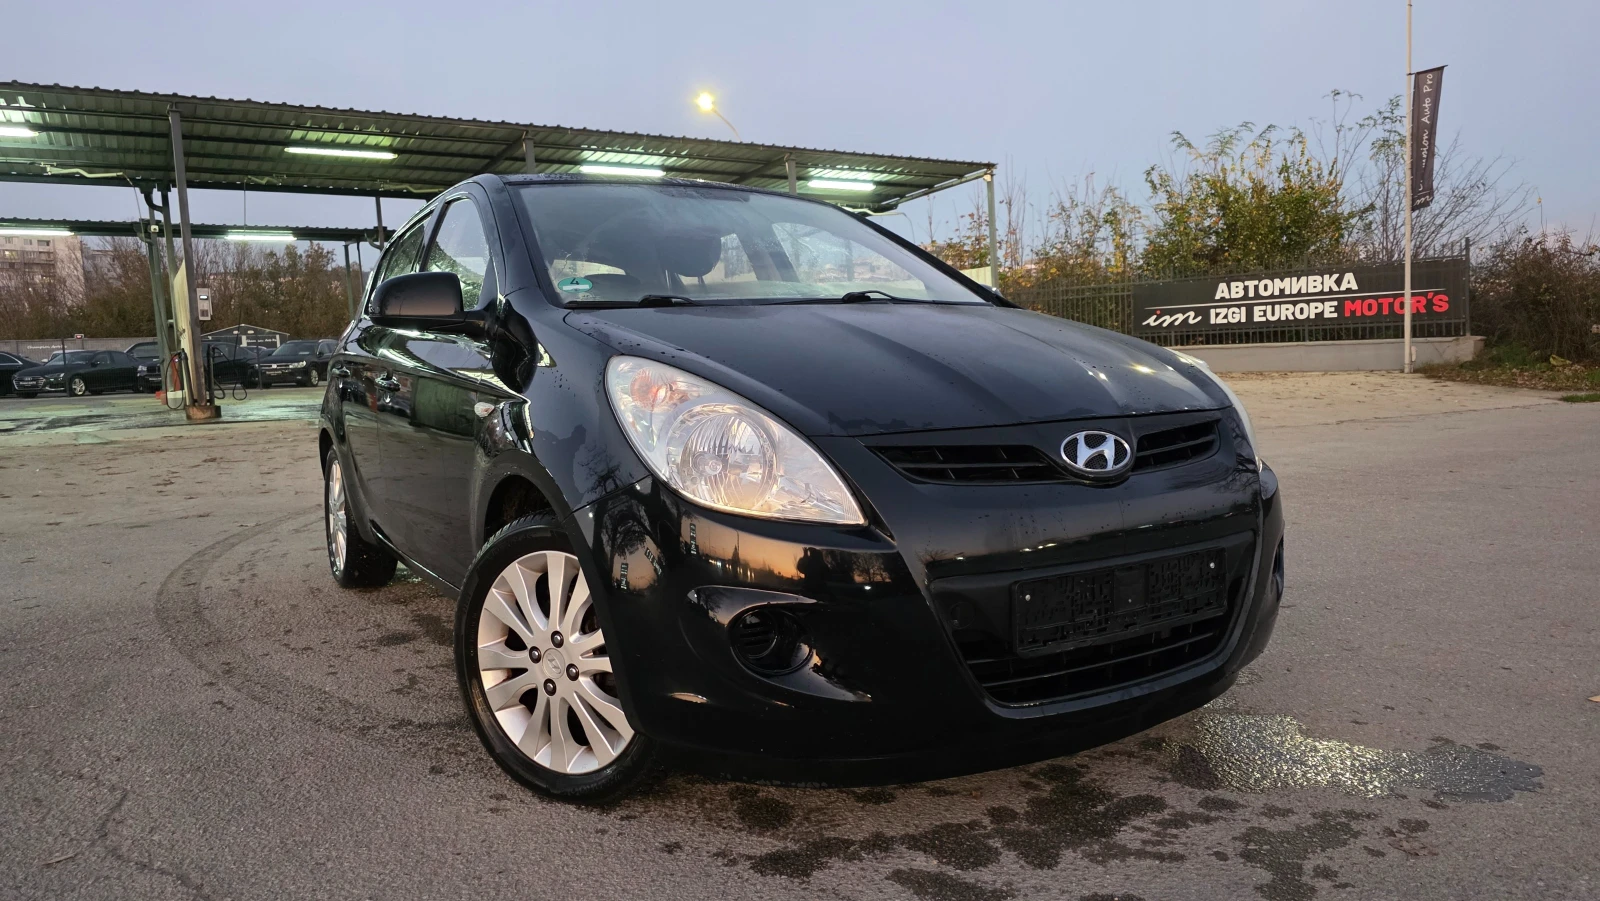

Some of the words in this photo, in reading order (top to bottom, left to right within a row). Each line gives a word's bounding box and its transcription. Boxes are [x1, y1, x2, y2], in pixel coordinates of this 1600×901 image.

[1423, 73, 1433, 93] Pro
[1420, 97, 1431, 124] Auto
[570, 277, 579, 285] 4
[1215, 272, 1358, 299] АВТОМИВКА
[1210, 306, 1246, 324] IZGI
[1253, 301, 1338, 322] EUROPE
